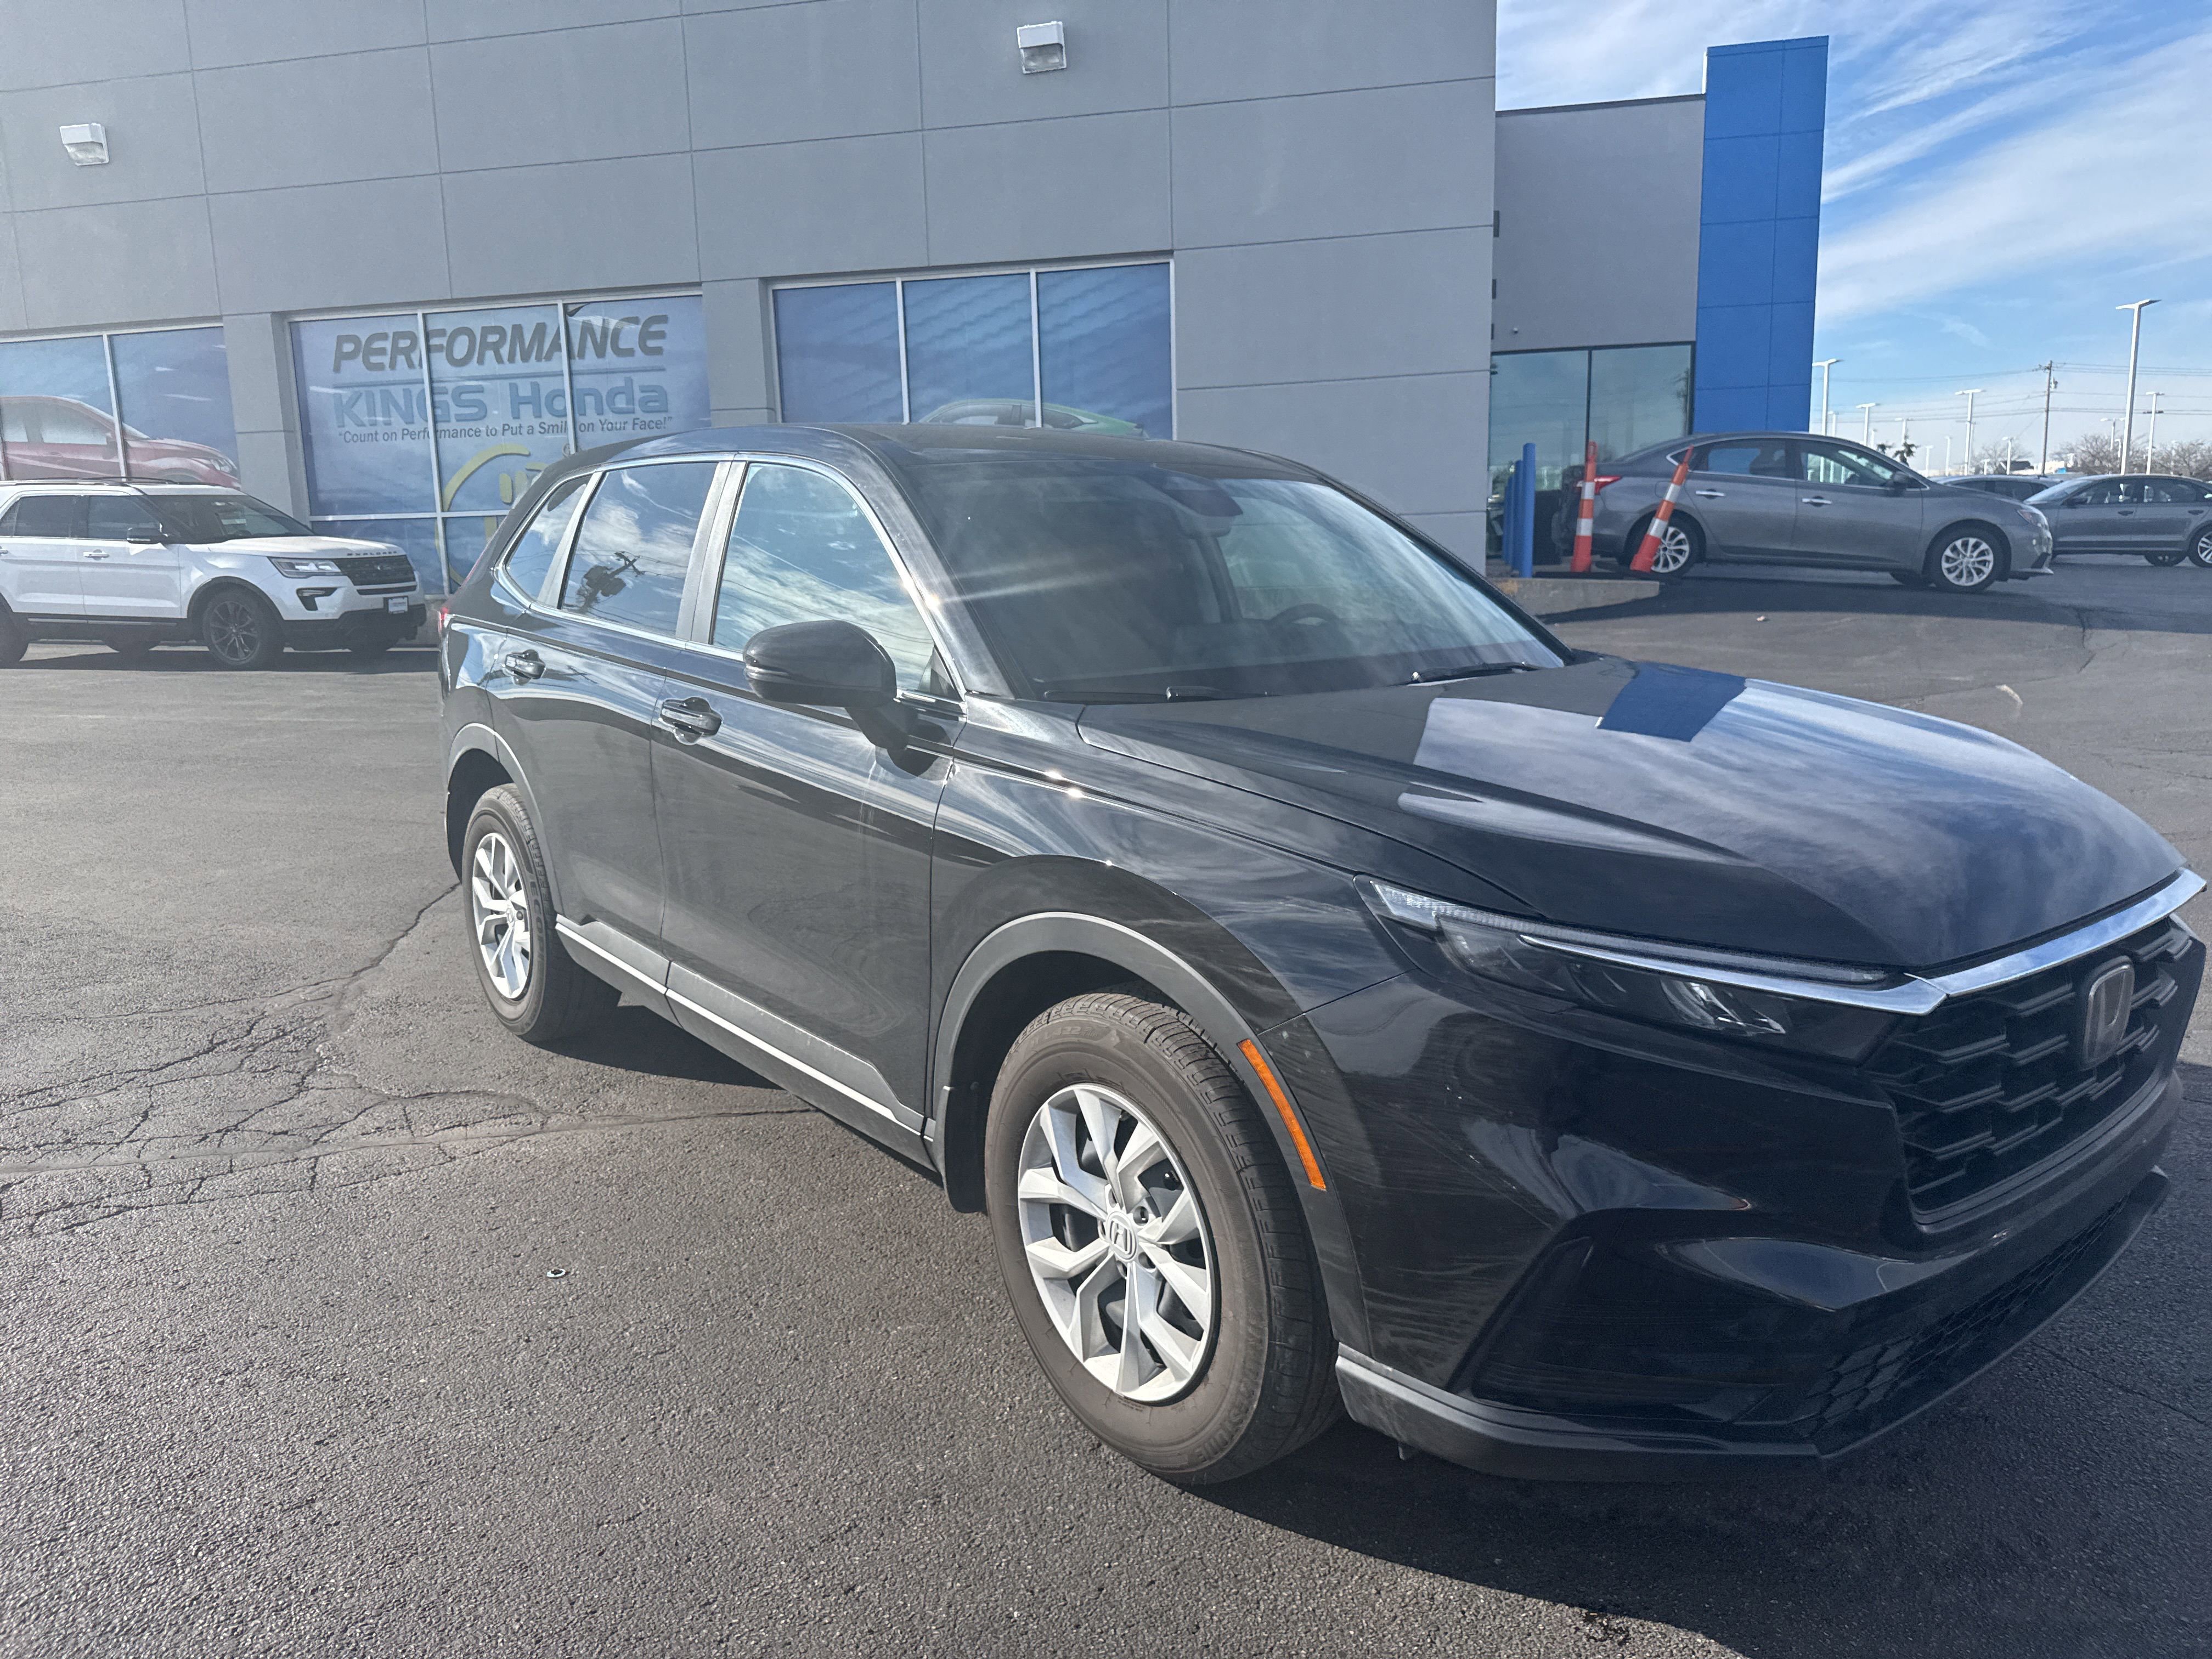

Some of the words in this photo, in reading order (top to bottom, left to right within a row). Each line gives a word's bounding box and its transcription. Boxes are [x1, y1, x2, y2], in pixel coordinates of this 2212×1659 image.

[333, 315, 668, 373] PERFORMANCE
[332, 385, 487, 428] KINGS
[509, 377, 668, 419] Honda
[382, 432, 397, 442] on
[402, 427, 481, 440] Perfmance
[486, 425, 497, 437] to
[502, 423, 522, 436] Put
[527, 425, 534, 435] a
[538, 421, 568, 434] Smil
[579, 422, 594, 432] on
[599, 419, 628, 431] Your
